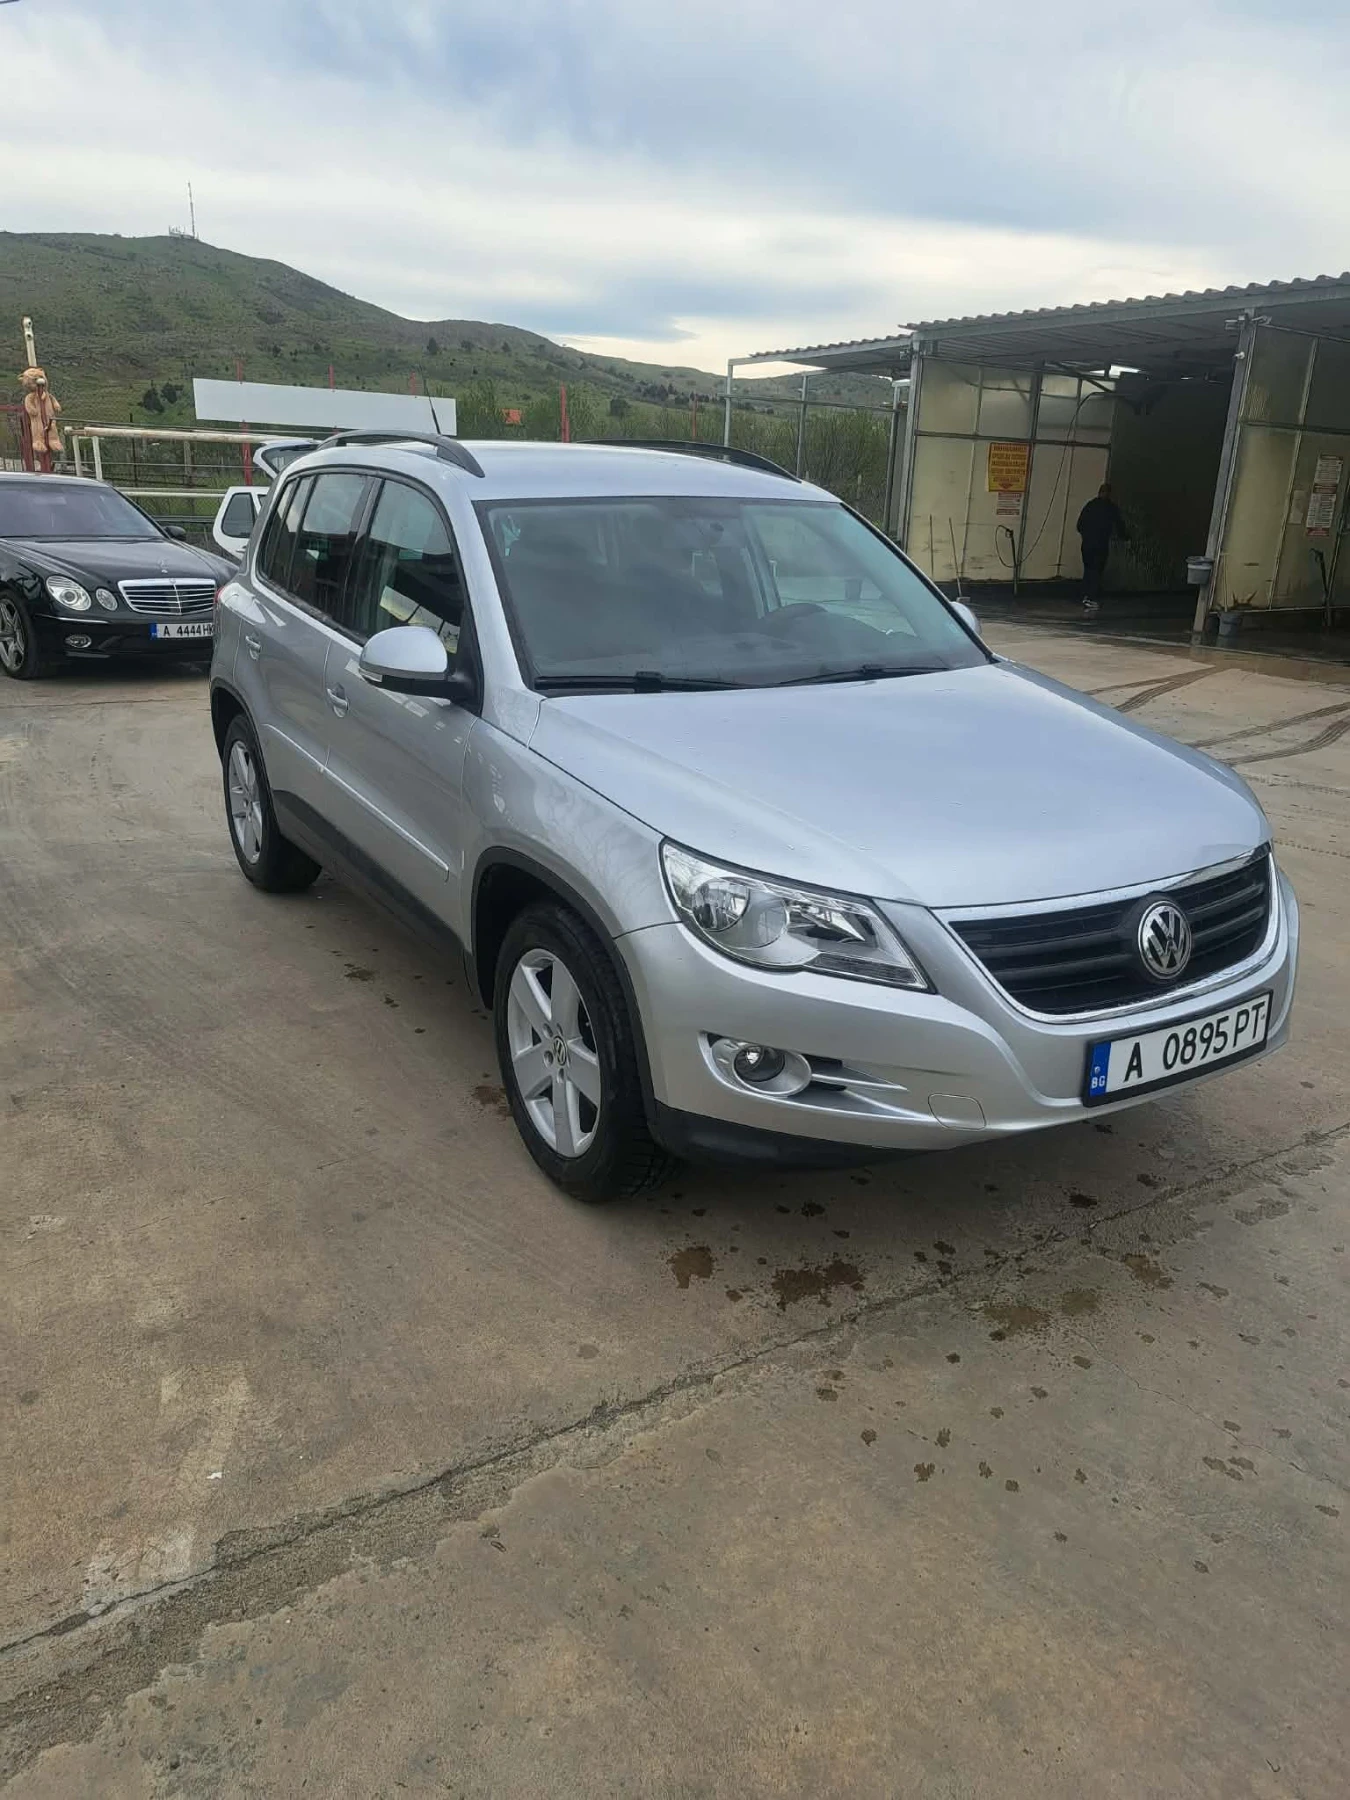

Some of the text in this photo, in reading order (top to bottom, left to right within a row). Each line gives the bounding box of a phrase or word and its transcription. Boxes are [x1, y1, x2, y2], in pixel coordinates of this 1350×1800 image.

[163, 625, 171, 636] A
[1123, 1041, 1143, 1082] A
[1091, 1075, 1106, 1089] BG
